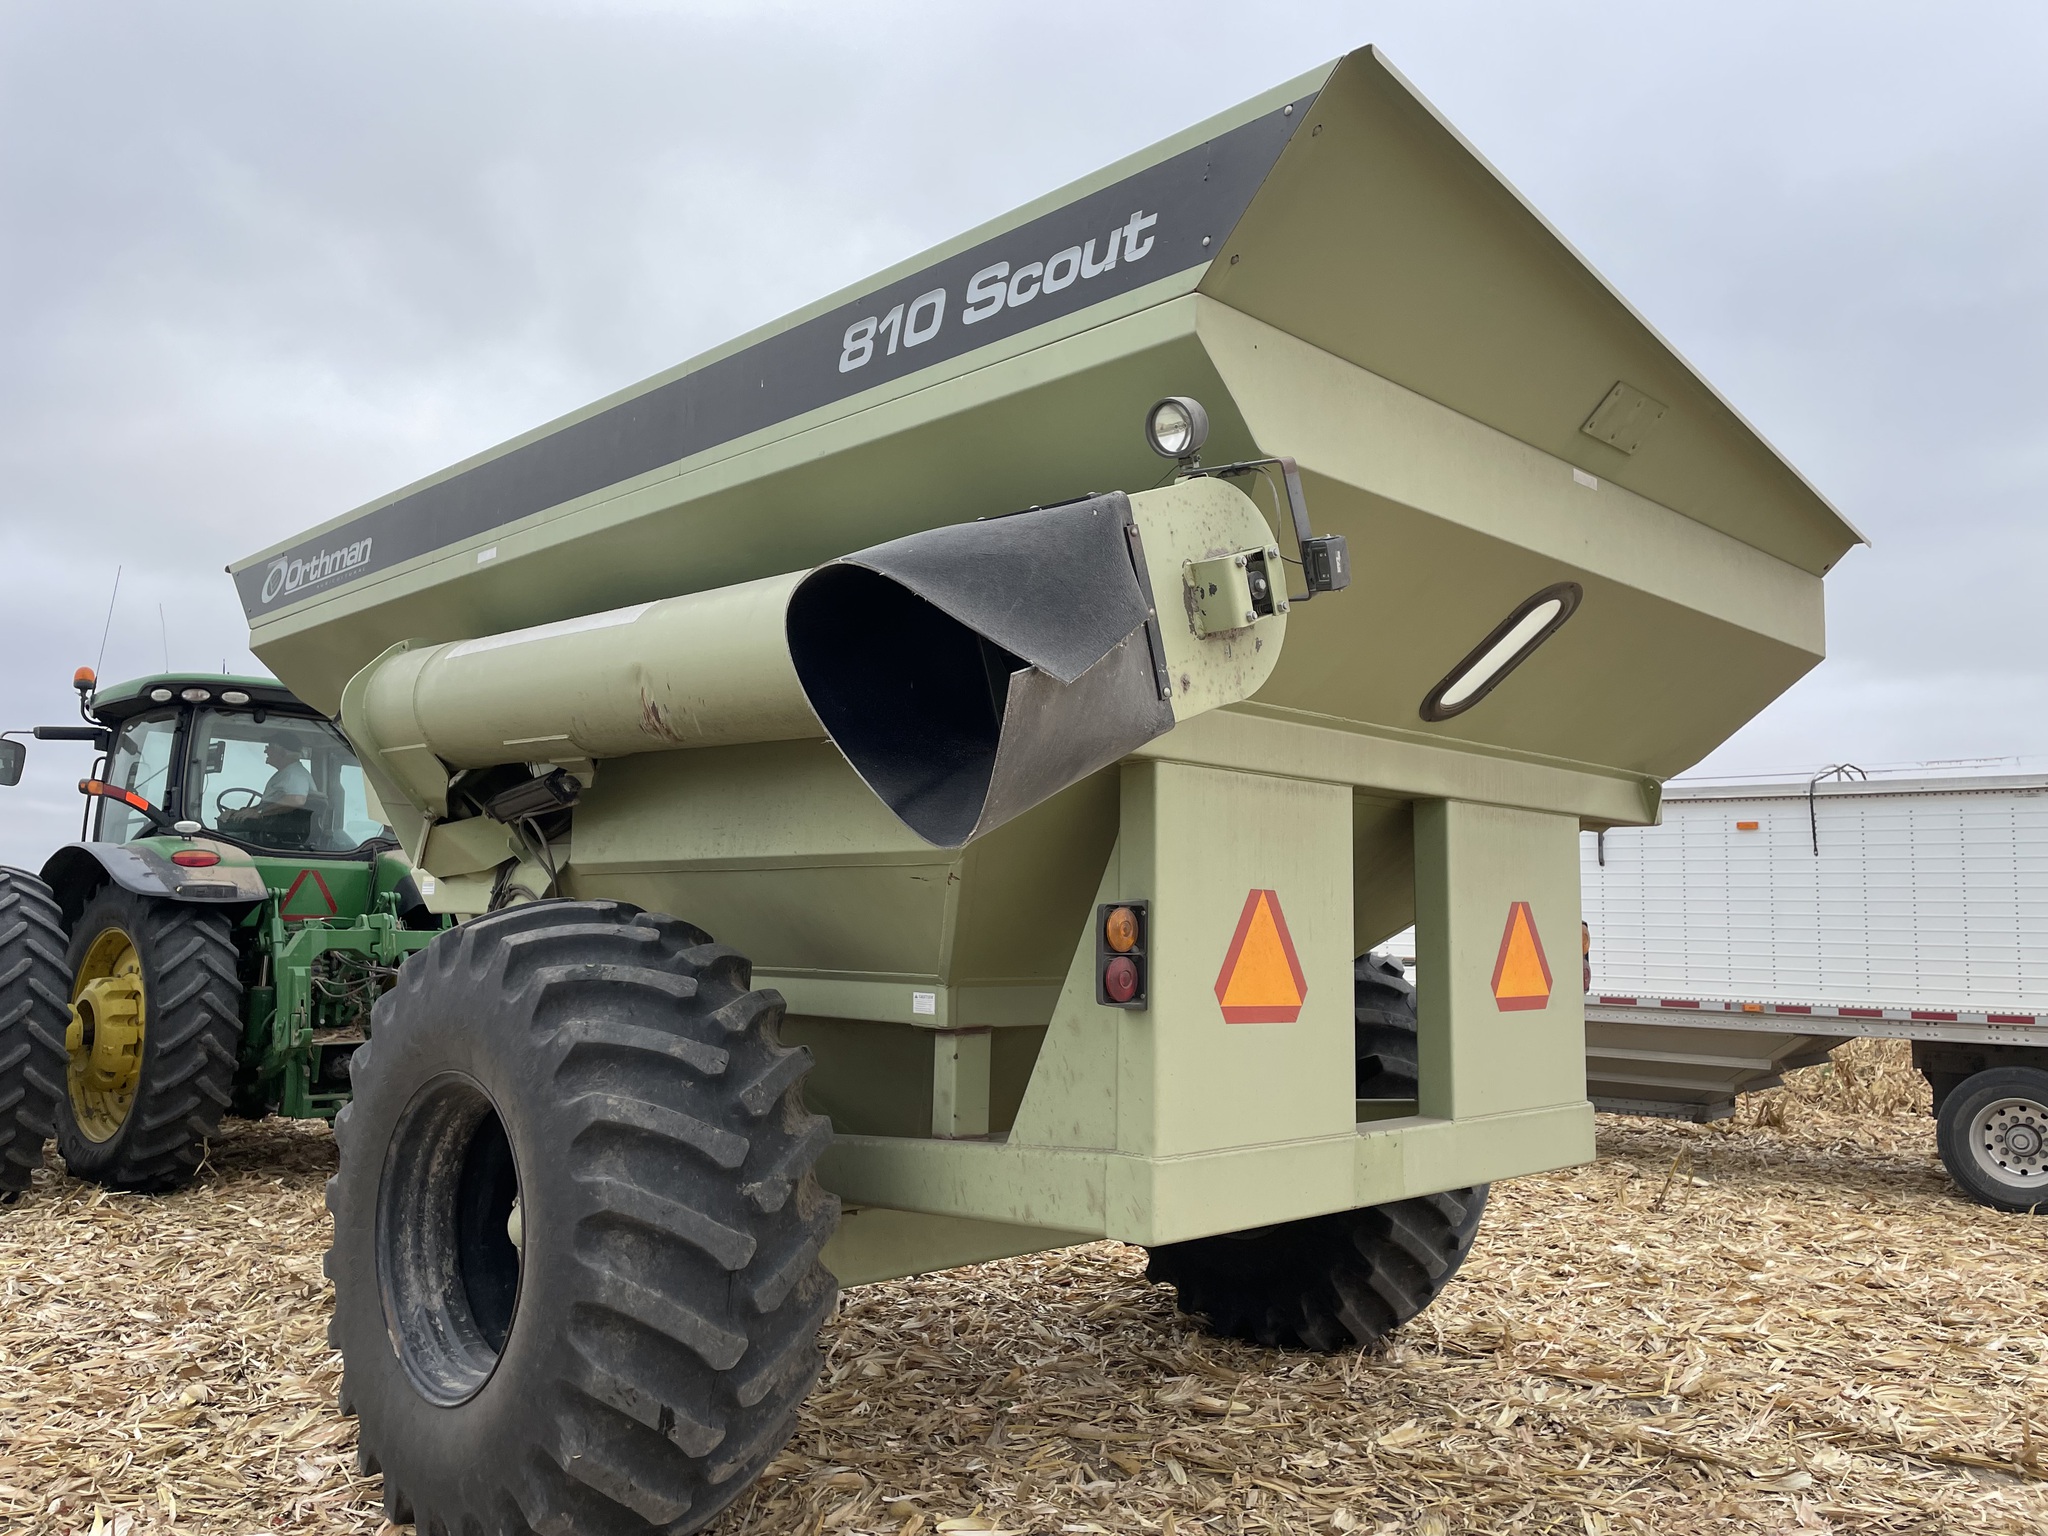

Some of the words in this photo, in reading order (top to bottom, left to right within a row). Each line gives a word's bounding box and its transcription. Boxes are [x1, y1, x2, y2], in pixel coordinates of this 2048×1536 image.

[838, 288, 946, 373] 810
[962, 210, 1157, 325] Scout
[285, 537, 372, 590] Orthman
